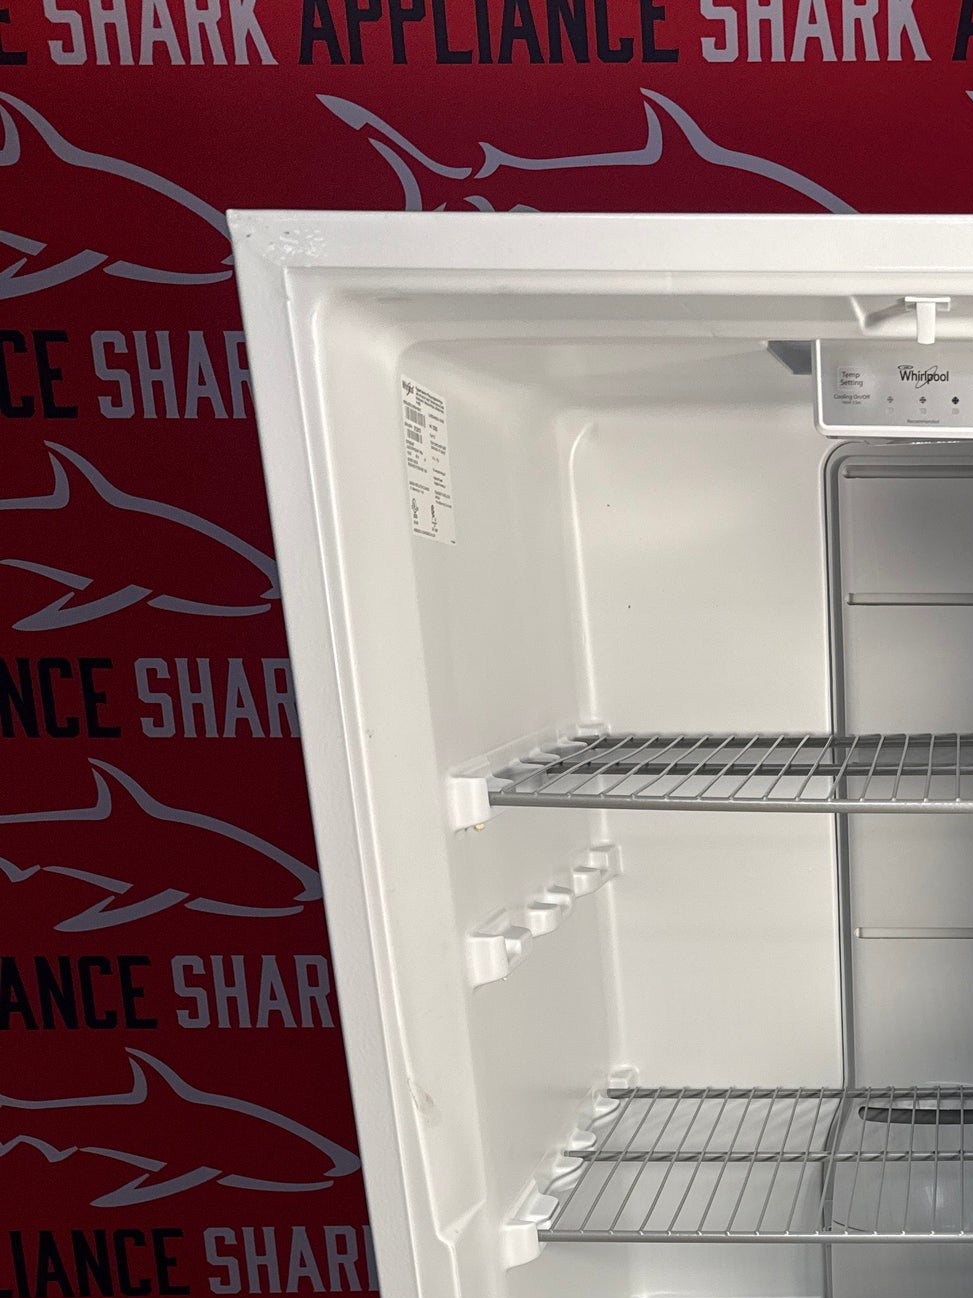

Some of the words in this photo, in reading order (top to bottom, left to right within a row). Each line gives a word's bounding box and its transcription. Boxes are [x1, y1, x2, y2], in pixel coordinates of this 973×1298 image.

[45, 0, 278, 65] SHARK
[299, 0, 679, 64] APPLIANCE
[701, 0, 932, 62] SHARK
[840, 379, 864, 387] Setting
[841, 371, 861, 379] Temp
[899, 368, 950, 386] Whirlpool
[171, 955, 335, 1029] SHAR
